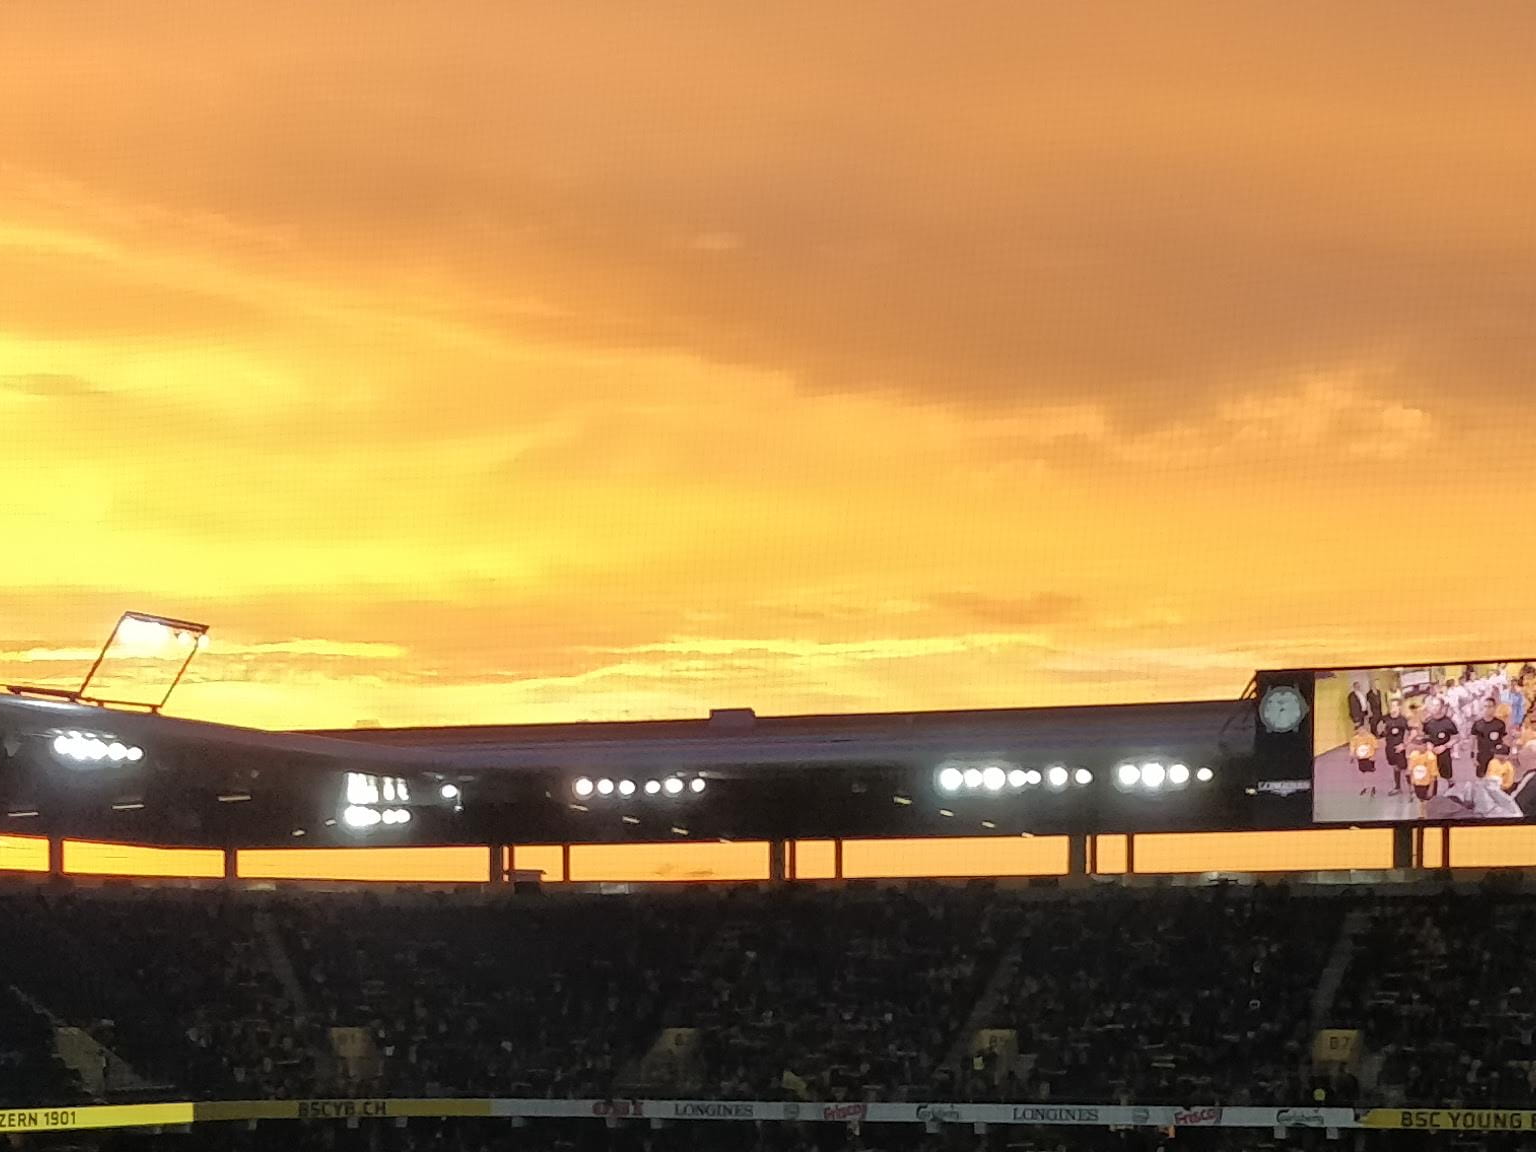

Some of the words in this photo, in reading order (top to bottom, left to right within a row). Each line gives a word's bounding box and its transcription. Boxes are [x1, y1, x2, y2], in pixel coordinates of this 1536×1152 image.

[44, 1109, 77, 1127] 1901
[674, 1103, 754, 1118] LONGINES
[1012, 1107, 1099, 1122] LONGINES
[1400, 1112, 1441, 1128] BSC
[1448, 1112, 1522, 1128] YOUNG
